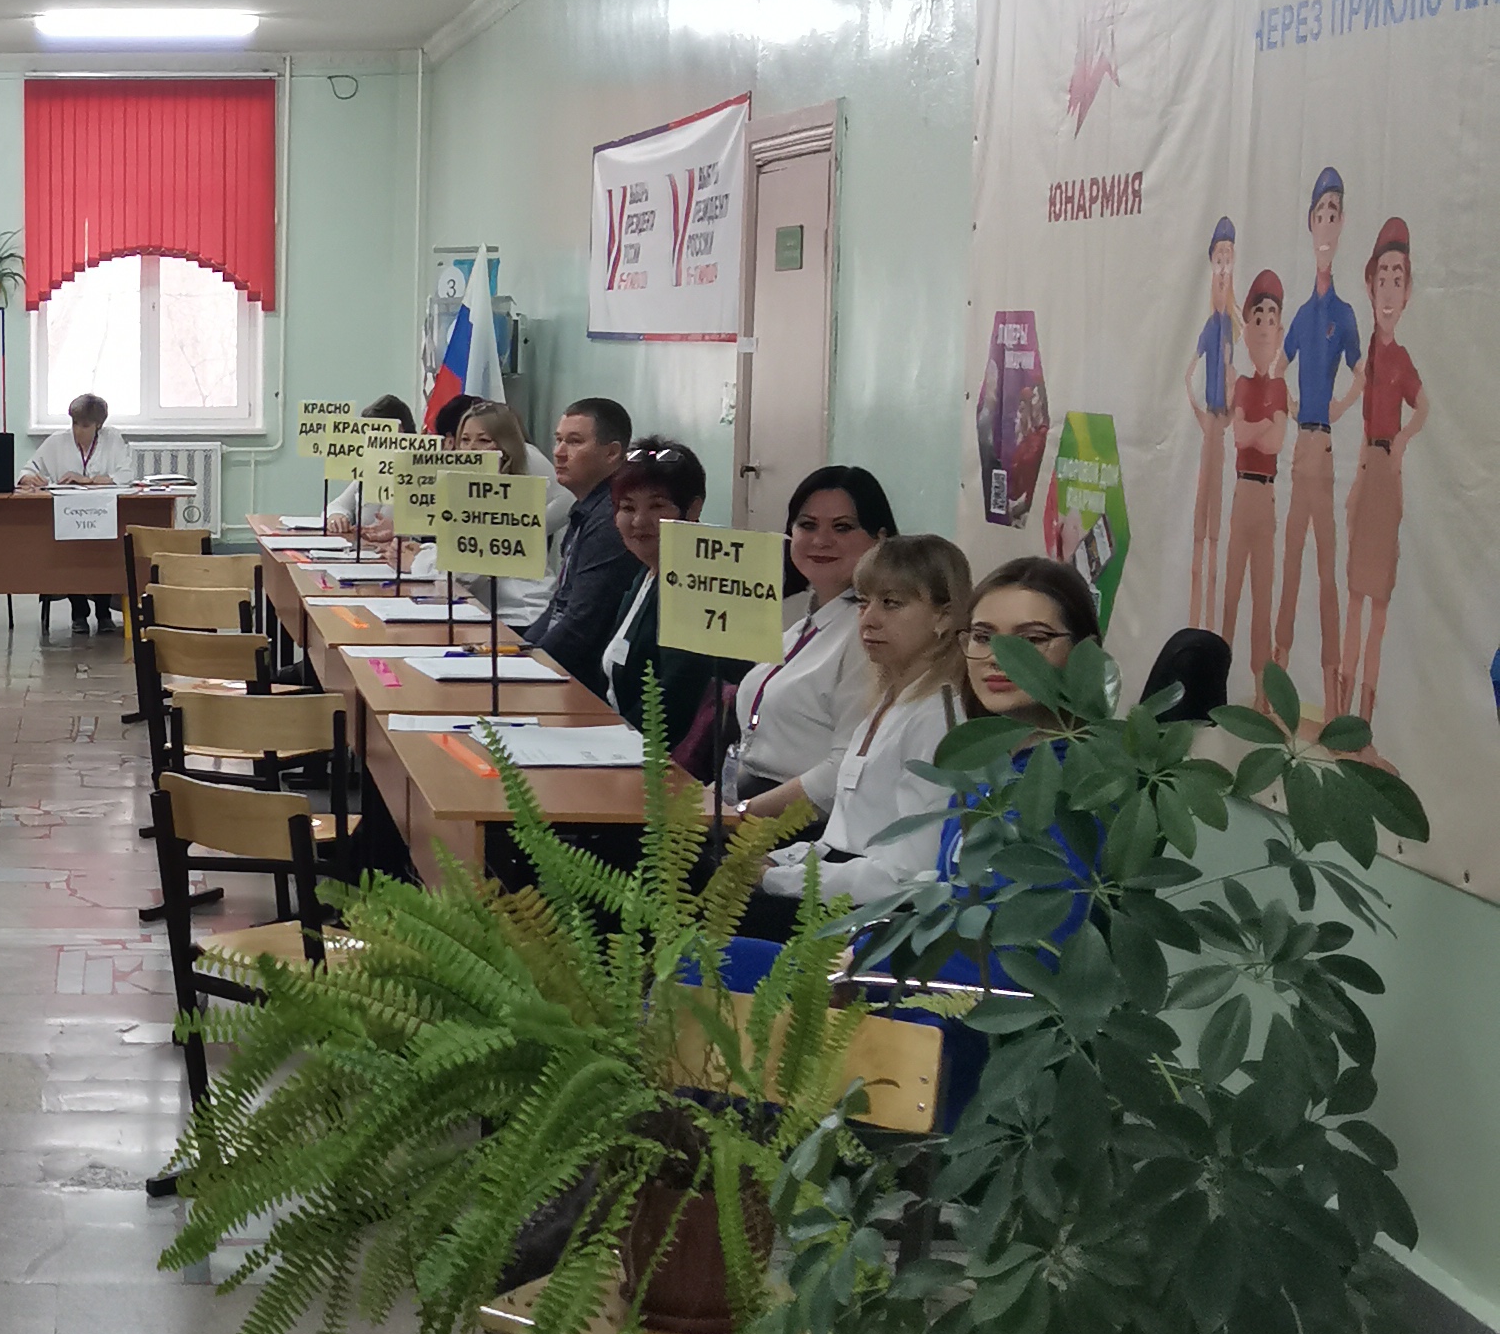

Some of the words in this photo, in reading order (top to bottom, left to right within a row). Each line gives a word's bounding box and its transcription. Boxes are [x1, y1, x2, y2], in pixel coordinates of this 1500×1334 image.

[1048, 170, 1143, 223] ЮНАРМИЯ
[446, 279, 457, 298] 3
[303, 403, 351, 414] КРАСНО
[332, 421, 393, 435] КРАСНО
[366, 436, 438, 451] МИНСКАЯ
[412, 453, 483, 465] МИНСКАЯ
[397, 473, 414, 485] 32
[468, 482, 511, 499] ПР-Т
[441, 509, 458, 523] Ф.
[461, 510, 542, 528] ЭНГЕЛЬСА
[457, 535, 484, 557] 69,
[489, 538, 527, 557] 69А
[695, 537, 745, 563] ПР-Т
[666, 570, 683, 587] Ф.
[686, 573, 778, 601] ЭНГЕЛЬСА
[704, 608, 728, 632] 71
